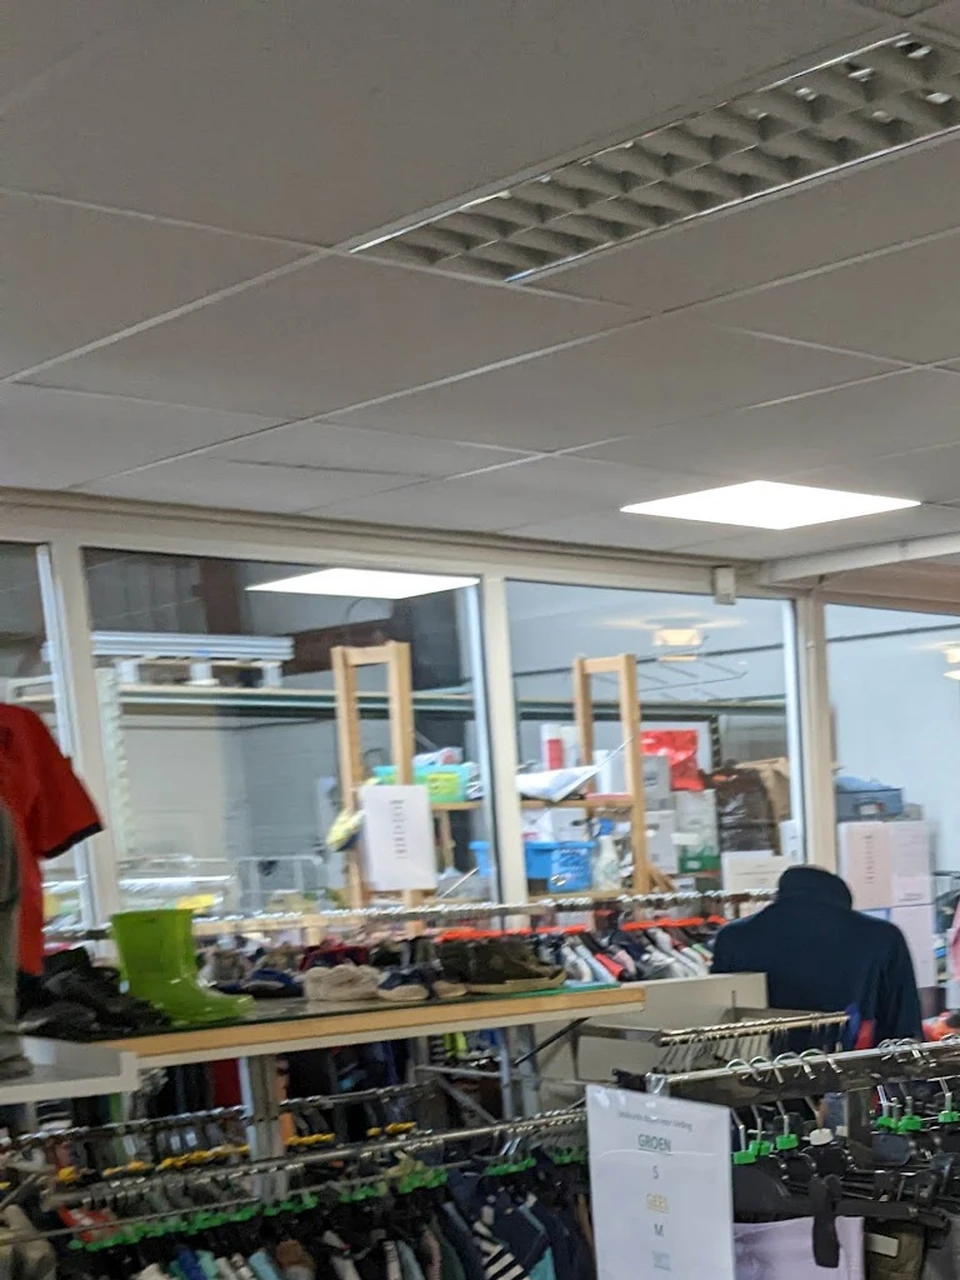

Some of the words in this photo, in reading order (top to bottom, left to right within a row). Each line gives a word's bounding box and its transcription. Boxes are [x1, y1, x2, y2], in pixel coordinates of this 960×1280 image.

[638, 1133, 672, 1153] GROEN
[652, 1165, 660, 1180] S
[654, 1222, 665, 1237] M
